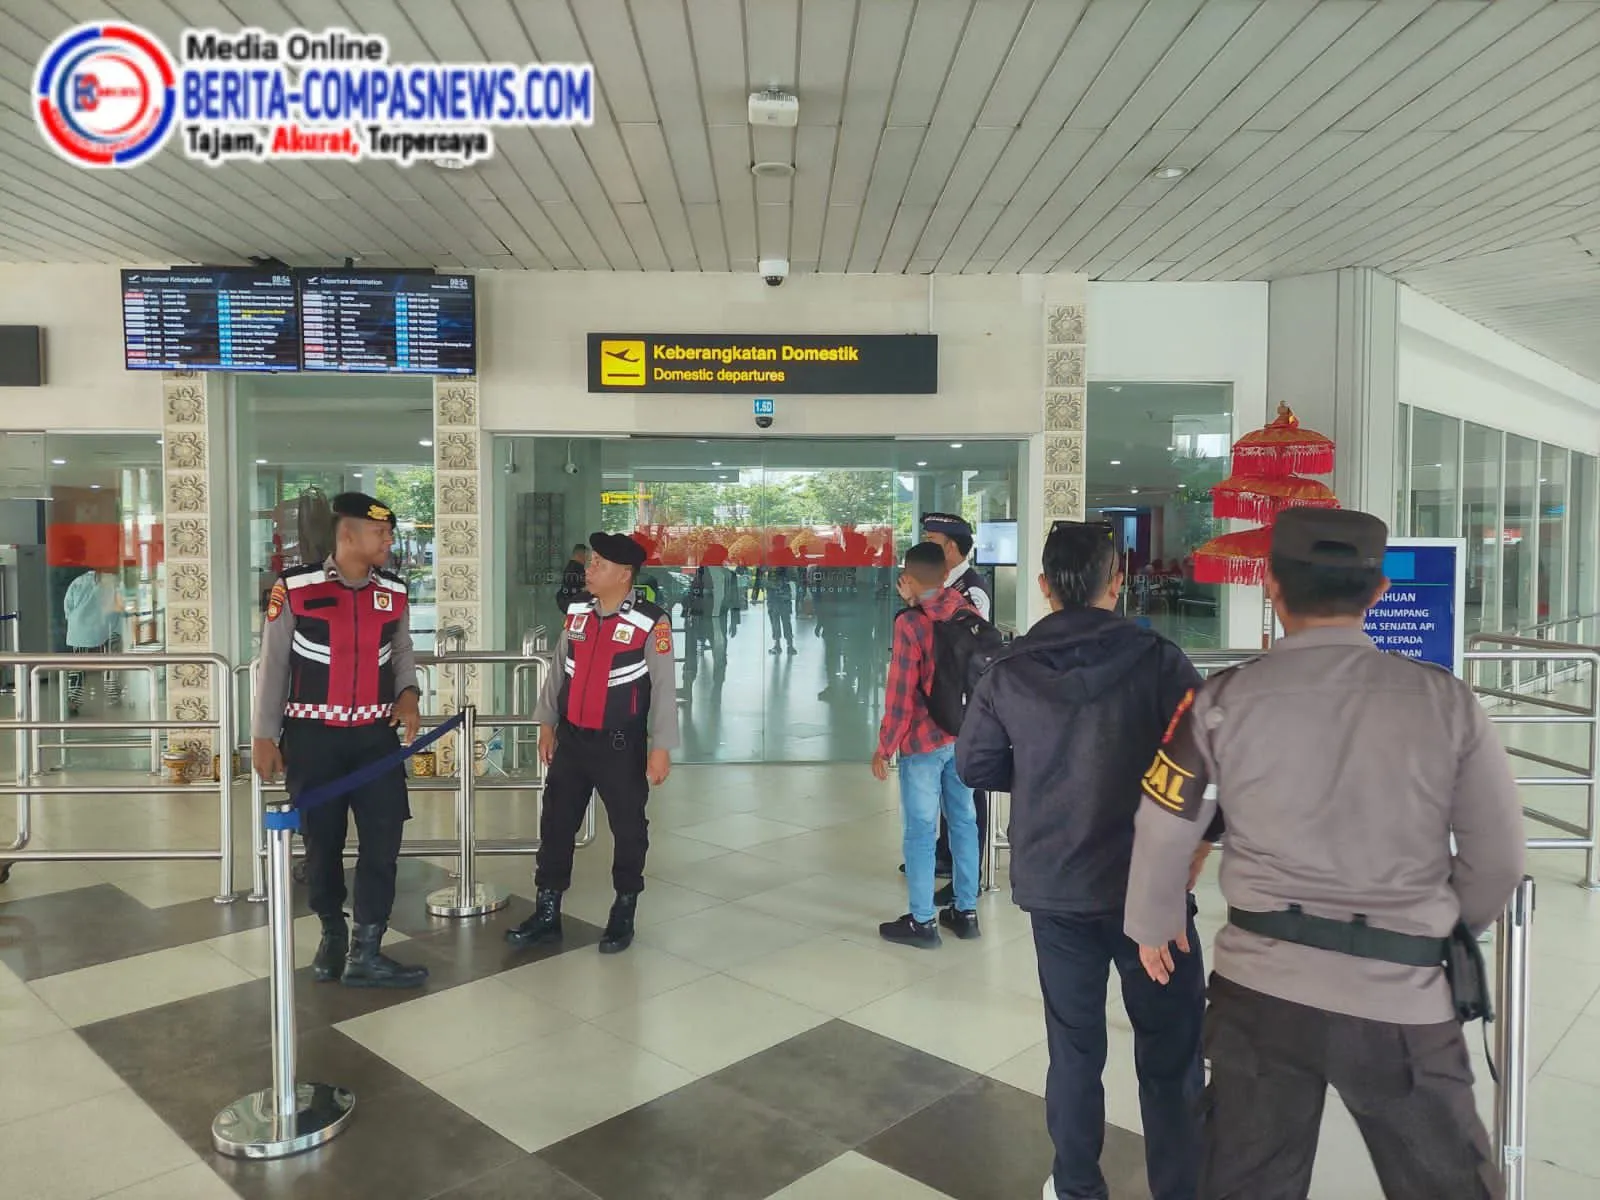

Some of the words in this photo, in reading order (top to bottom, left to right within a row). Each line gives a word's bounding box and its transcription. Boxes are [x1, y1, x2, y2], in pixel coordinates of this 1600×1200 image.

[653, 344, 777, 364] Keberangkatan
[782, 345, 859, 361] Domestik
[653, 367, 714, 381] Domestic
[717, 368, 785, 384] departures
[1368, 608, 1430, 618] PENUMPANG
[1379, 622, 1417, 631] SENJATA
[1419, 622, 1435, 631] API
[1386, 635, 1423, 645] KEPADA
